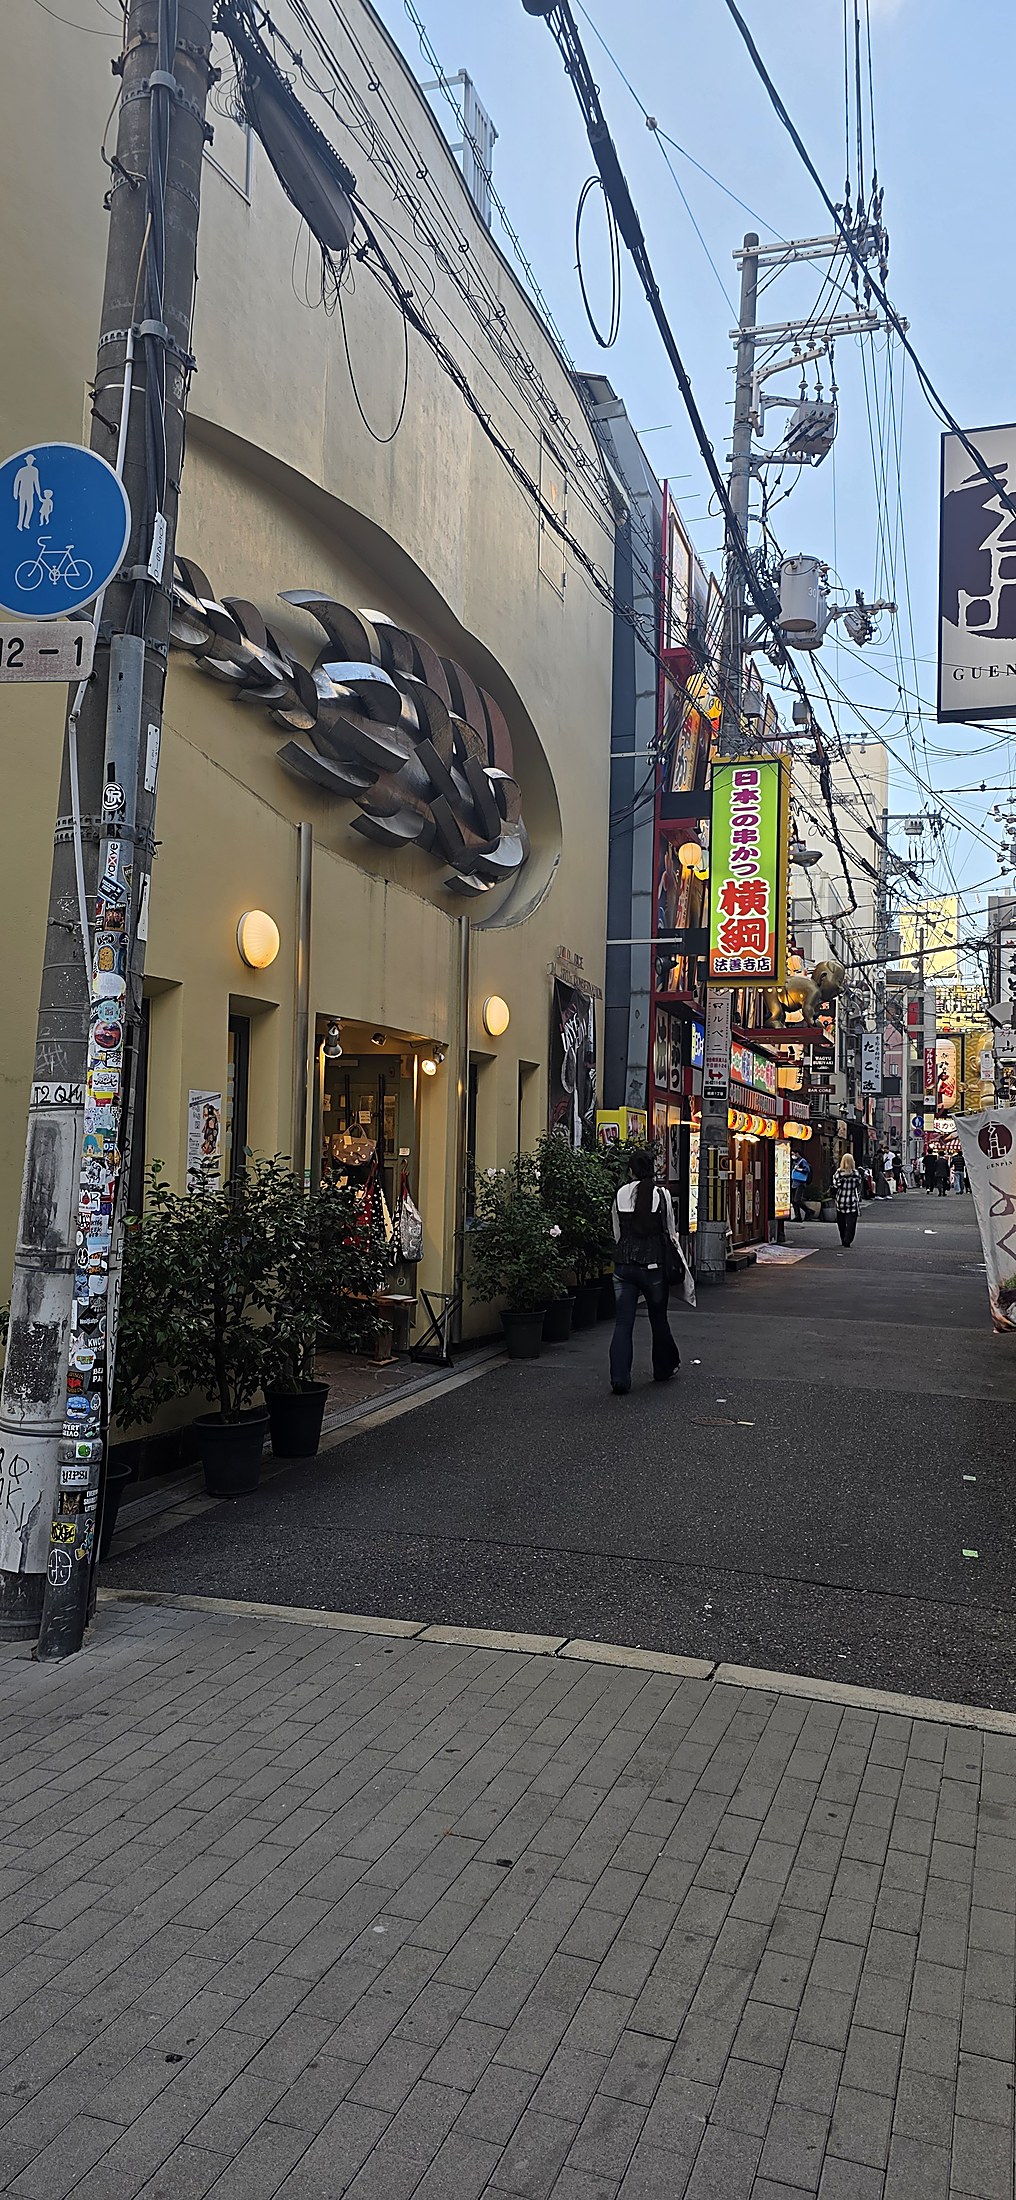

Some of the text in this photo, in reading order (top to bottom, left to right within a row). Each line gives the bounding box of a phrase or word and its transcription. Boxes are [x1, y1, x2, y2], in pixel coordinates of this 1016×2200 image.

[731, 769, 759, 876] 日本一の串かつ
[720, 880, 768, 954] 横綱
[714, 957, 771, 972] 法善寺店
